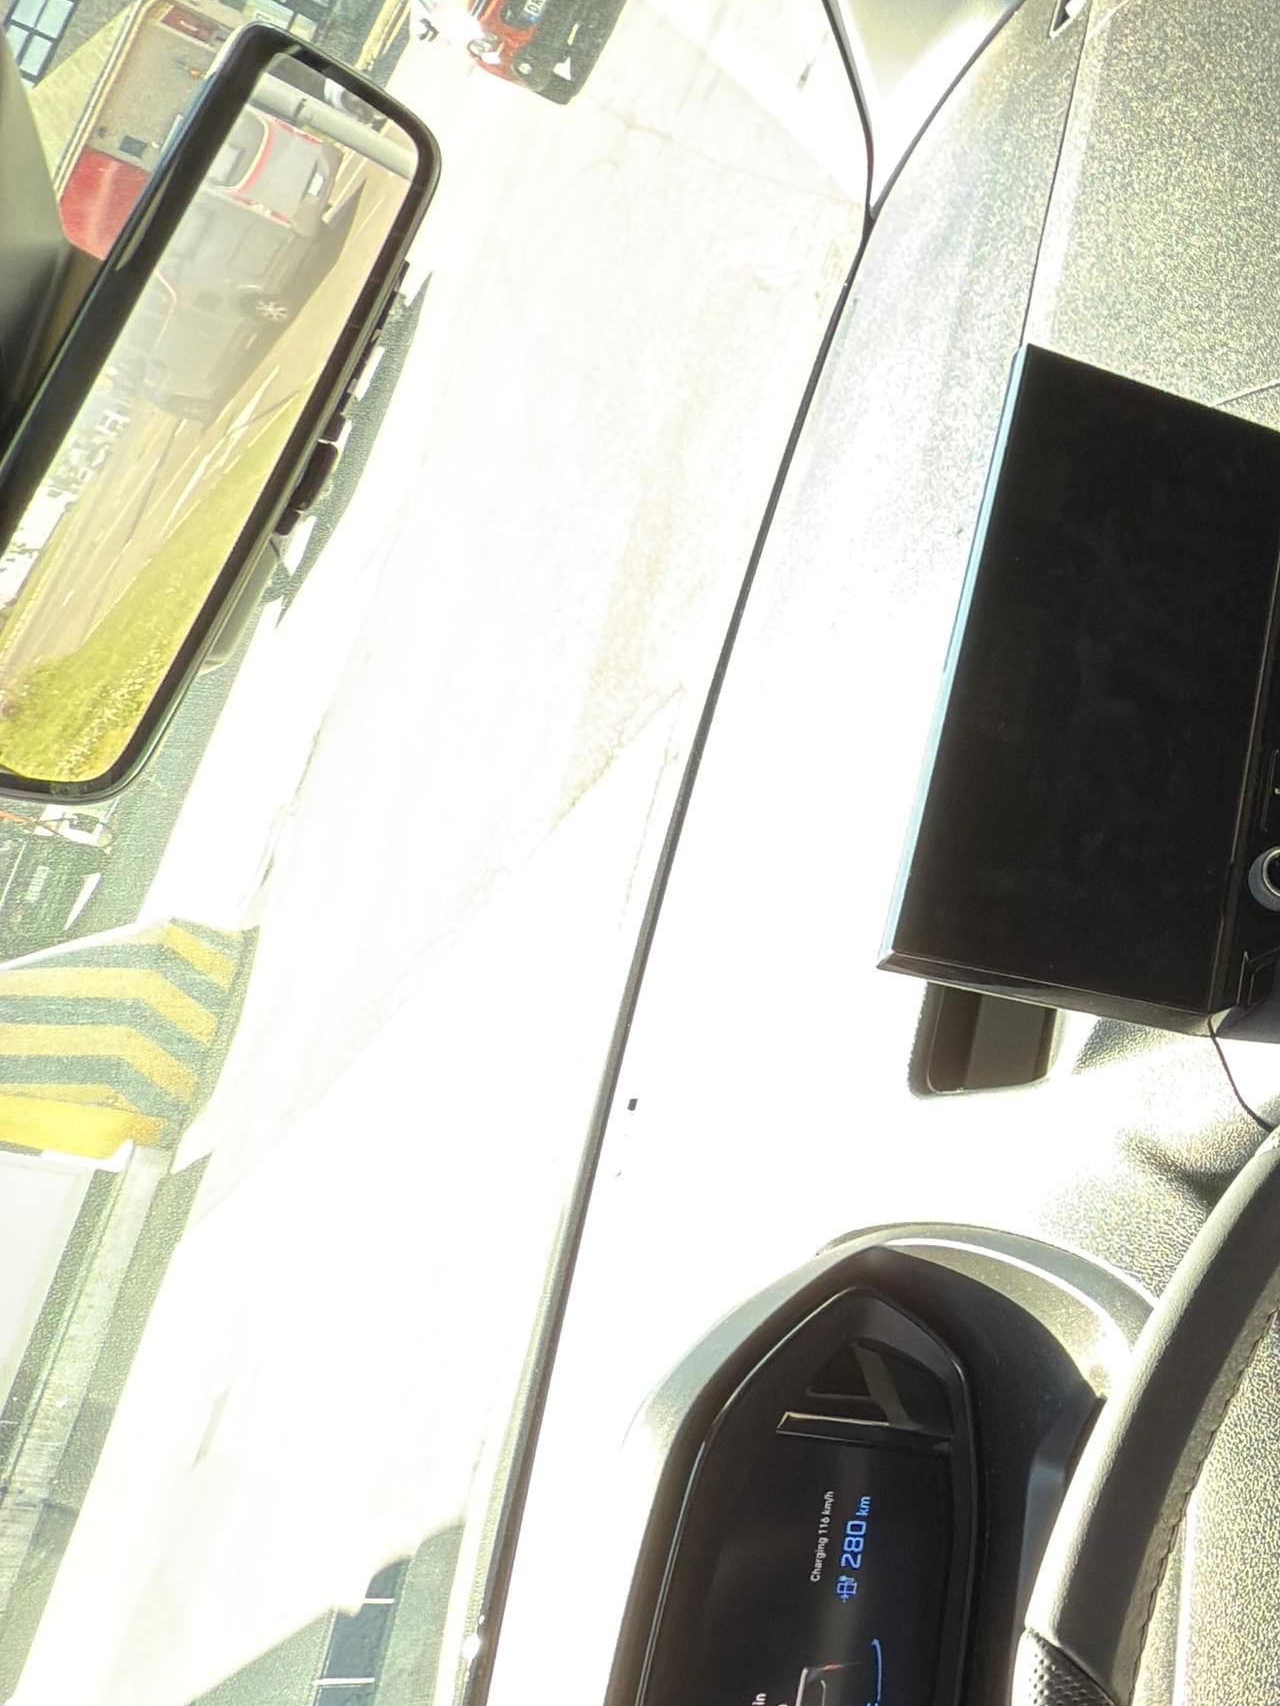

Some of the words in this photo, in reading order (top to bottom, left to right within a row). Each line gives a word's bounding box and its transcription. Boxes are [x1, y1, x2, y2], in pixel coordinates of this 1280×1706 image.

[821, 1491, 834, 1515] km/h
[818, 1516, 831, 1535] 116
[840, 1520, 867, 1569] 280
[855, 1496, 871, 1516] km
[810, 1537, 830, 1582] Charging
[752, 1693, 767, 1706] in
